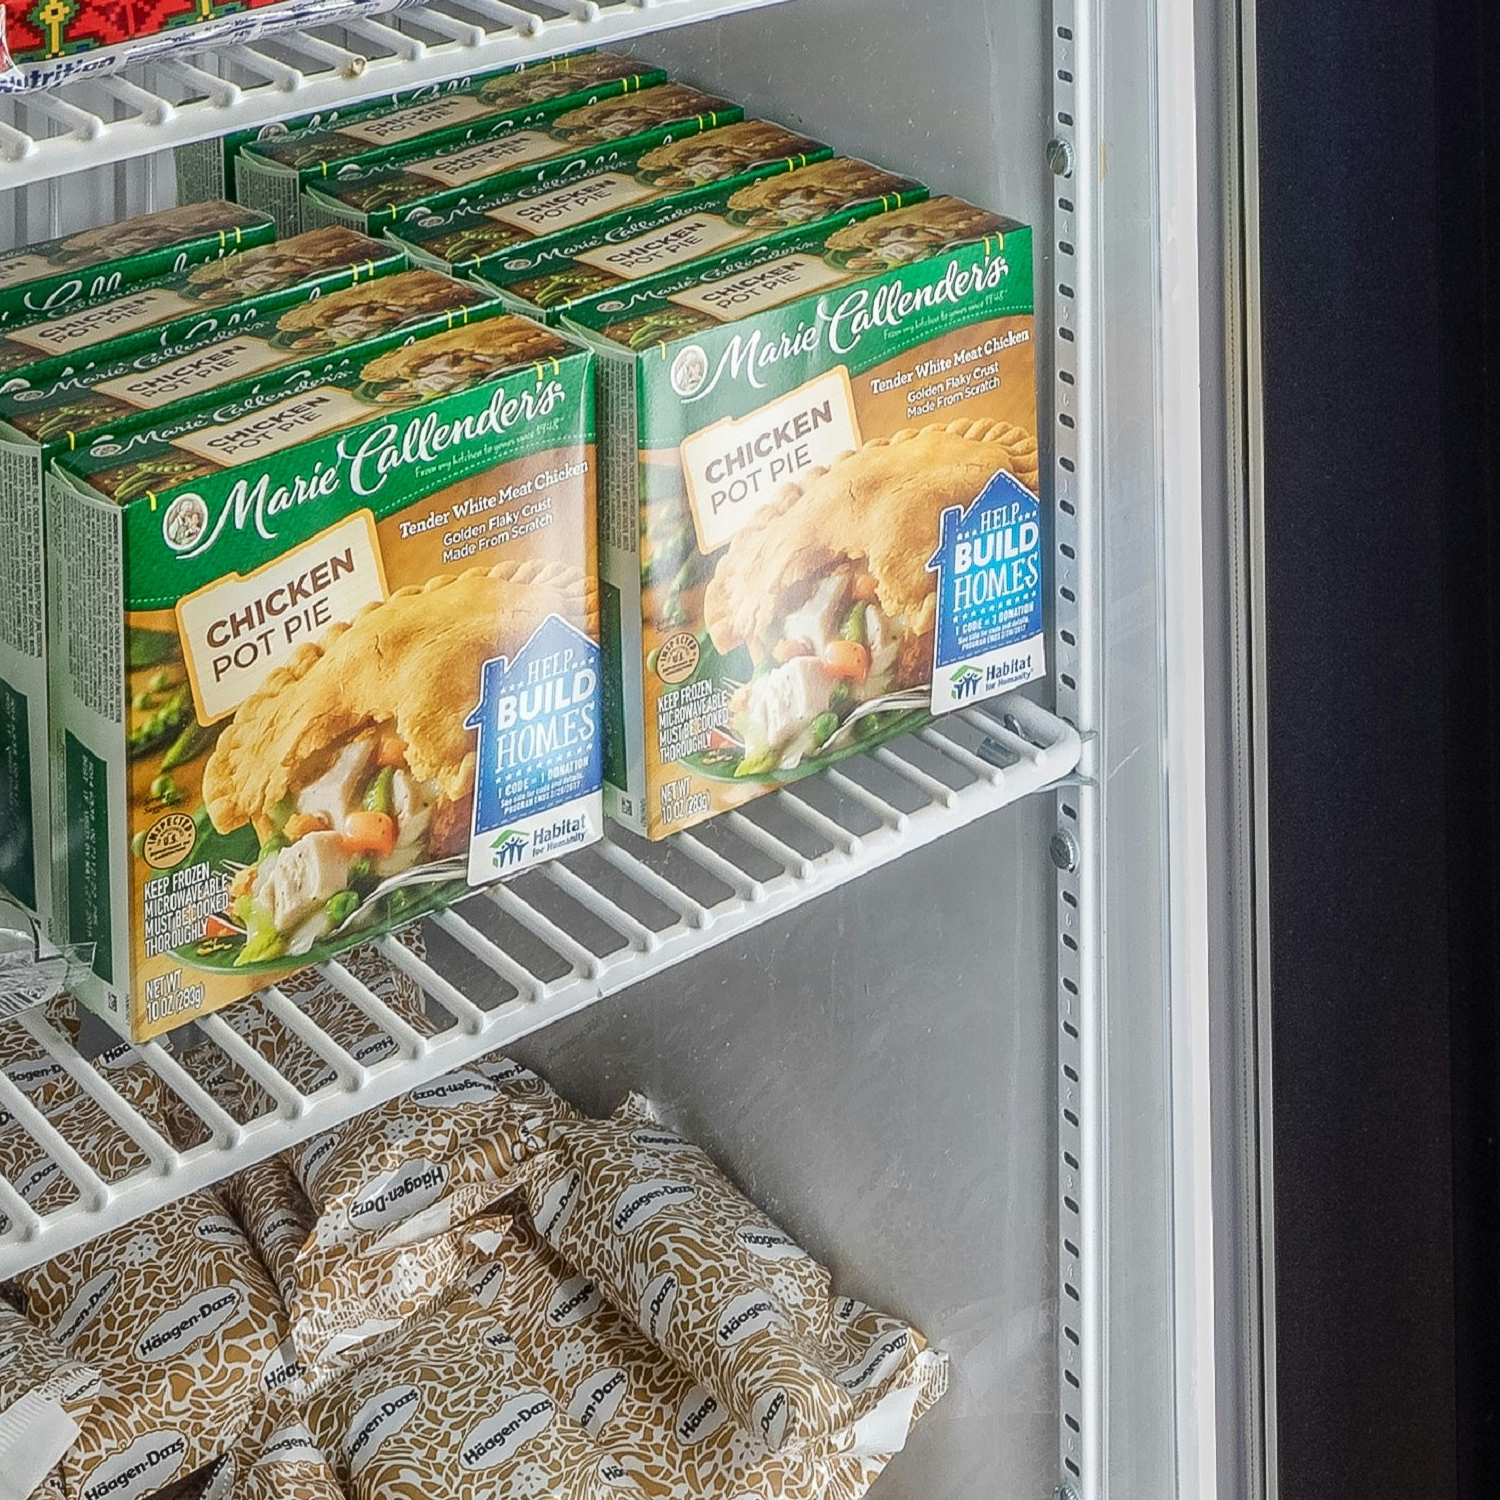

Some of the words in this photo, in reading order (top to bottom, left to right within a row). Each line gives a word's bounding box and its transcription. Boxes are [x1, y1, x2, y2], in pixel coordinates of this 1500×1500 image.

[362, 98, 464, 133] CHICKEN
[431, 136, 530, 175] CHICKEN
[514, 178, 616, 219] CHICKEN
[605, 221, 708, 267] CHICKEN
[701, 259, 805, 307] CHICKEN
[38, 295, 157, 338] CHICKEN
[127, 344, 247, 394] CHICKEN
[870, 372, 914, 394] Tender
[915, 358, 952, 378] White
[953, 345, 983, 367] Meat
[984, 329, 1030, 355] Chicken
[907, 383, 944, 404] Golden
[973, 362, 999, 380] Crust
[907, 401, 935, 418] Made
[937, 392, 964, 408] From
[965, 377, 1000, 398] Scratch
[207, 396, 332, 450] CHICKEN
[704, 399, 834, 486] CHICKEN
[176, 460, 342, 560] Marie
[337, 380, 567, 500] Callender's
[710, 472, 763, 516] POT
[771, 444, 813, 485] PIE
[399, 511, 450, 539] Tender
[452, 496, 497, 521] White
[499, 484, 533, 505] Meat
[534, 460, 589, 491] Chicken
[443, 524, 486, 546] Golden
[489, 508, 523, 531] Flaky
[522, 497, 553, 516] Crust
[442, 544, 476, 564] Made
[479, 531, 509, 551] From
[512, 512, 553, 539] Scratch
[955, 522, 1039, 574] BUILD
[206, 547, 356, 649] CHICKEN
[953, 552, 1039, 613] HOMES
[213, 627, 274, 682] POT
[284, 595, 333, 644] PIE
[528, 648, 573, 685] HELP
[986, 654, 1032, 681] Habitat
[497, 669, 597, 731] BUILD
[658, 690, 728, 729] MICROWAVEABLE
[495, 700, 595, 773] HOMES
[659, 730, 712, 765] THOROUGHLY
[548, 758, 589, 780] DONATION
[533, 814, 586, 846] Habitat
[547, 832, 588, 852] Humanity
[144, 877, 170, 898] KEEP
[172, 861, 210, 891] FROZEN
[144, 873, 229, 918] MICROWAVEABLE
[145, 913, 173, 937] MUST
[191, 892, 229, 922] COOKED
[145, 918, 209, 958] THOROUGHLY
[146, 976, 165, 1000] NET
[175, 984, 205, 1013] (283g)
[351, 1166, 447, 1218] Häagen-Dazs
[139, 1291, 239, 1356] Häagen-Dazs
[462, 1397, 555, 1466] Häagen-Dazs
[84, 1436, 186, 1500] Häagen-Dazs
